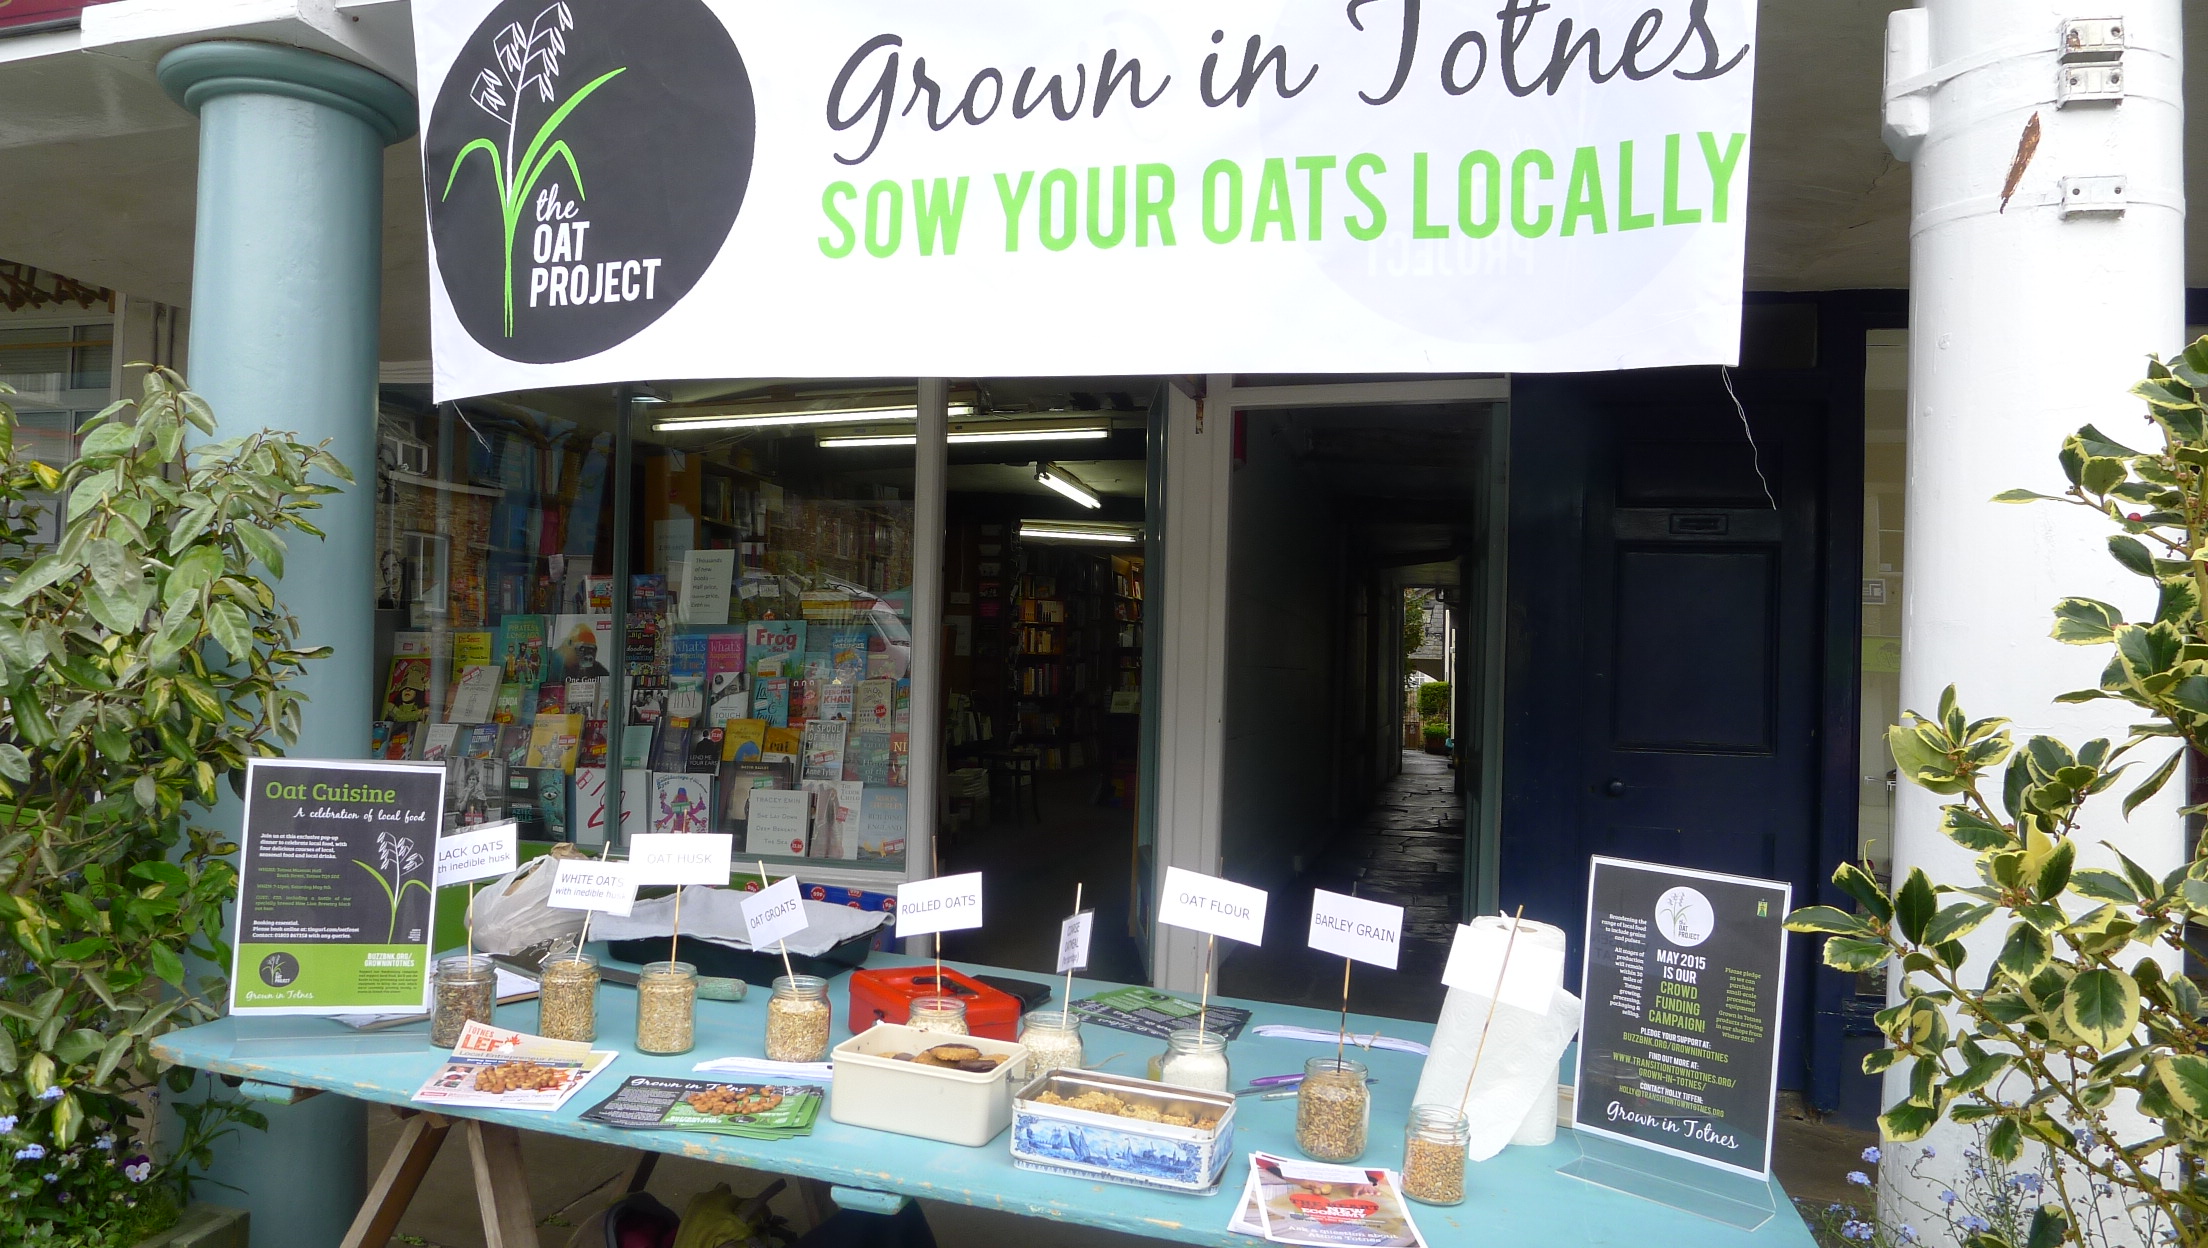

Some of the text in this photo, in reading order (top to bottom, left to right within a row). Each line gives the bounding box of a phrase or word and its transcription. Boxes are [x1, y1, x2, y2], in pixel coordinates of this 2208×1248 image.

[827, 34, 1171, 165] Grown
[1200, 29, 1319, 107] in
[536, 183, 579, 222] the
[817, 130, 1746, 258] SOW YOUR OATS LOCALLY
[533, 220, 590, 264] OAT
[530, 258, 662, 308] PROJECT
[711, 641, 740, 652] What's
[756, 628, 798, 650] Frog
[566, 676, 577, 684] One
[824, 696, 850, 704] KHAN
[817, 724, 841, 732] SPOOL
[822, 734, 841, 742] BLUE
[806, 768, 820, 776] Anne
[266, 782, 396, 803] Oat Cuisine
[294, 807, 426, 823] A celebration of local food
[439, 840, 503, 861] LACK OATS
[647, 854, 712, 864] OAT HUSK
[450, 852, 510, 871] inedible husk
[561, 873, 624, 887] WHITE OATS
[555, 887, 572, 895] with
[574, 888, 603, 898] inedible
[750, 899, 797, 929] OAT GROATS
[901, 894, 976, 915] ROLLED OATS
[1179, 892, 1250, 920] OAT FLOUR
[1315, 913, 1395, 943] BARLEY GRAIN
[1678, 931, 1700, 940] PROJECT
[1657, 949, 1706, 970] MAY 2015
[1663, 966, 1697, 984] IS OUR
[246, 990, 273, 1001] Grown
[287, 990, 314, 999] Totnes
[1660, 981, 1698, 1000] CROWD
[1656, 995, 1700, 1016] FUNDING
[1649, 1009, 1706, 1033] CAMPAIGN!
[468, 1025, 495, 1038] TOTNES
[1641, 1027, 1711, 1049] PLEDGE YOUR SUPPORT AT:
[461, 1034, 505, 1052] LEF
[1623, 1031, 1729, 1063] BUZZBNK.ORG/GROWNINTOTNES
[1648, 1051, 1661, 1061] FIND
[1662, 1055, 1673, 1063] OUT
[1674, 1057, 1690, 1067] MORE
[1613, 1051, 1736, 1089] WWW.TRANSITIONTOWNTOTNES.ORG/
[631, 1077, 682, 1090] Grown
[1638, 1068, 1707, 1092] GROWN-IN-TOTNES/
[1640, 1082, 1665, 1095] CONTACT
[1665, 1088, 1682, 1099] HOLLY
[1607, 1101, 1739, 1149] Grown in Totnes
[1301, 1208, 1367, 1218] ECONOMY
[1326, 1206, 1365, 1214] NEW
